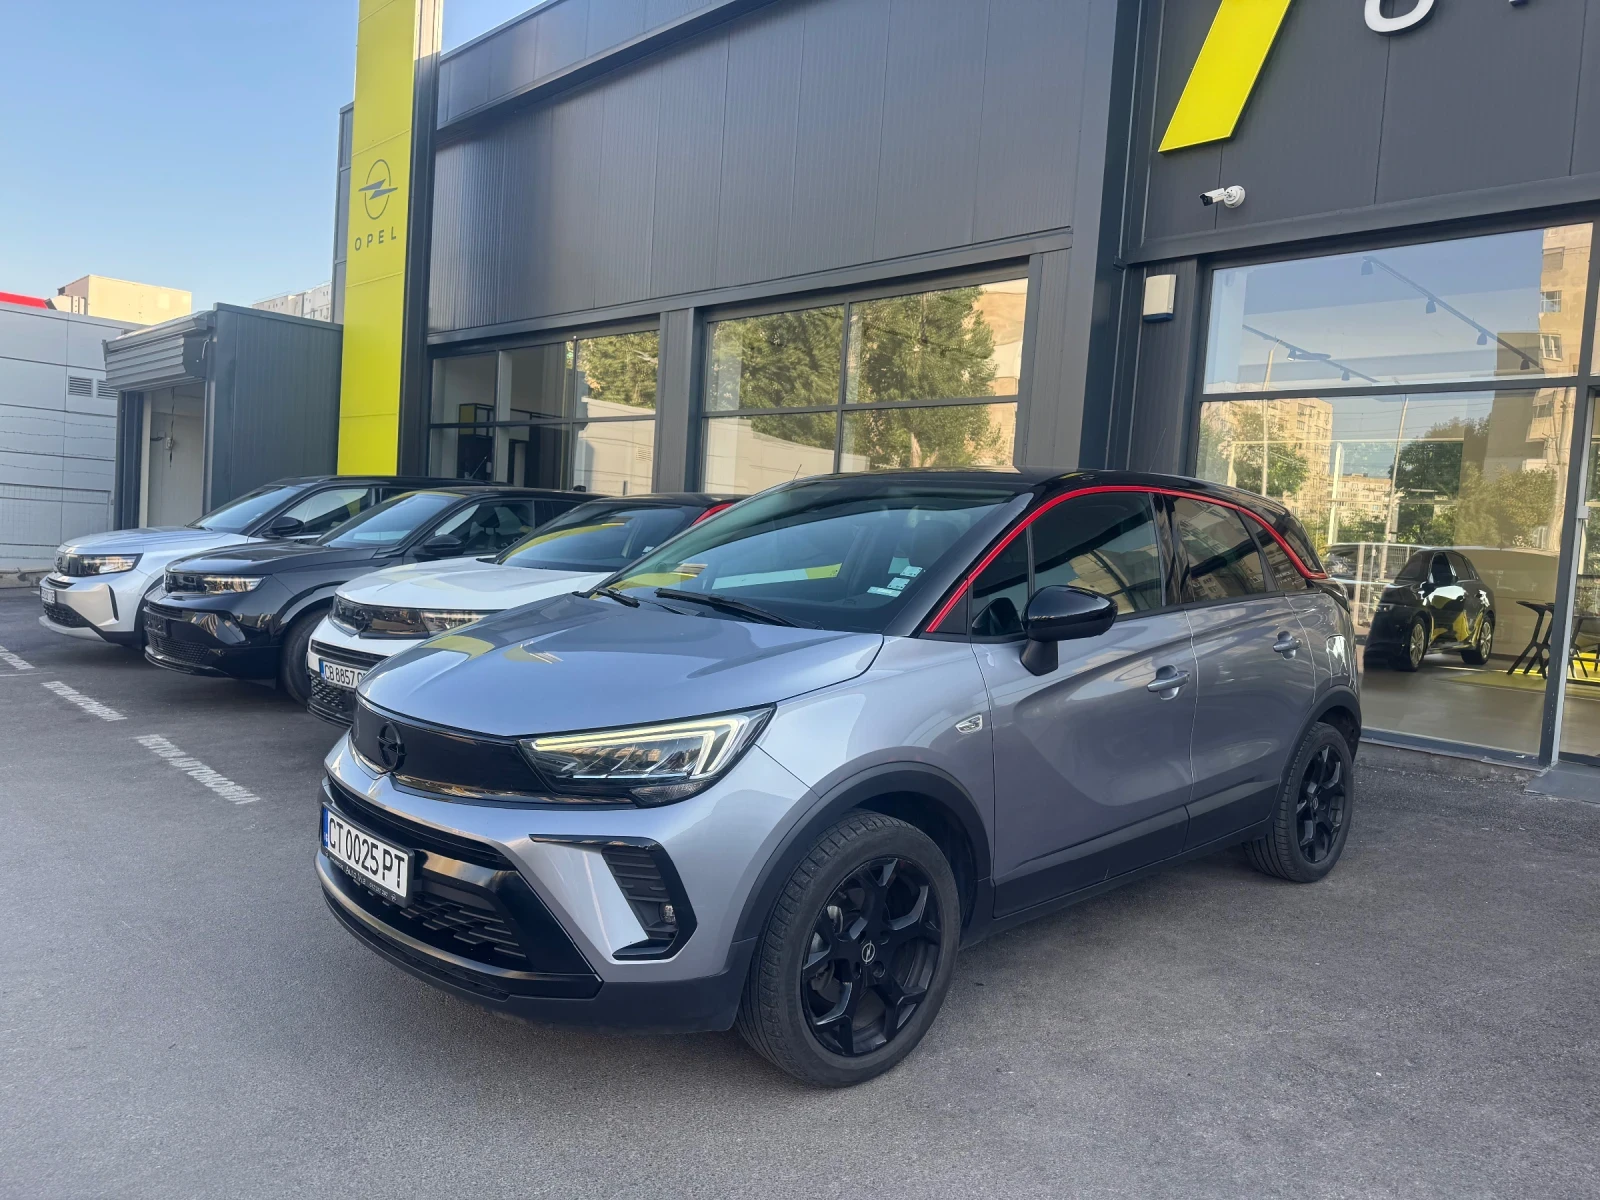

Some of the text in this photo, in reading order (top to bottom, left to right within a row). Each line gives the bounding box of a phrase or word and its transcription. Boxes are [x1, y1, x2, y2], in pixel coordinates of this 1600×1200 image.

[355, 226, 396, 251] OPEL
[325, 665, 334, 680] CB
[336, 668, 354, 685] 8857
[330, 818, 404, 888] CT 0025 PT
